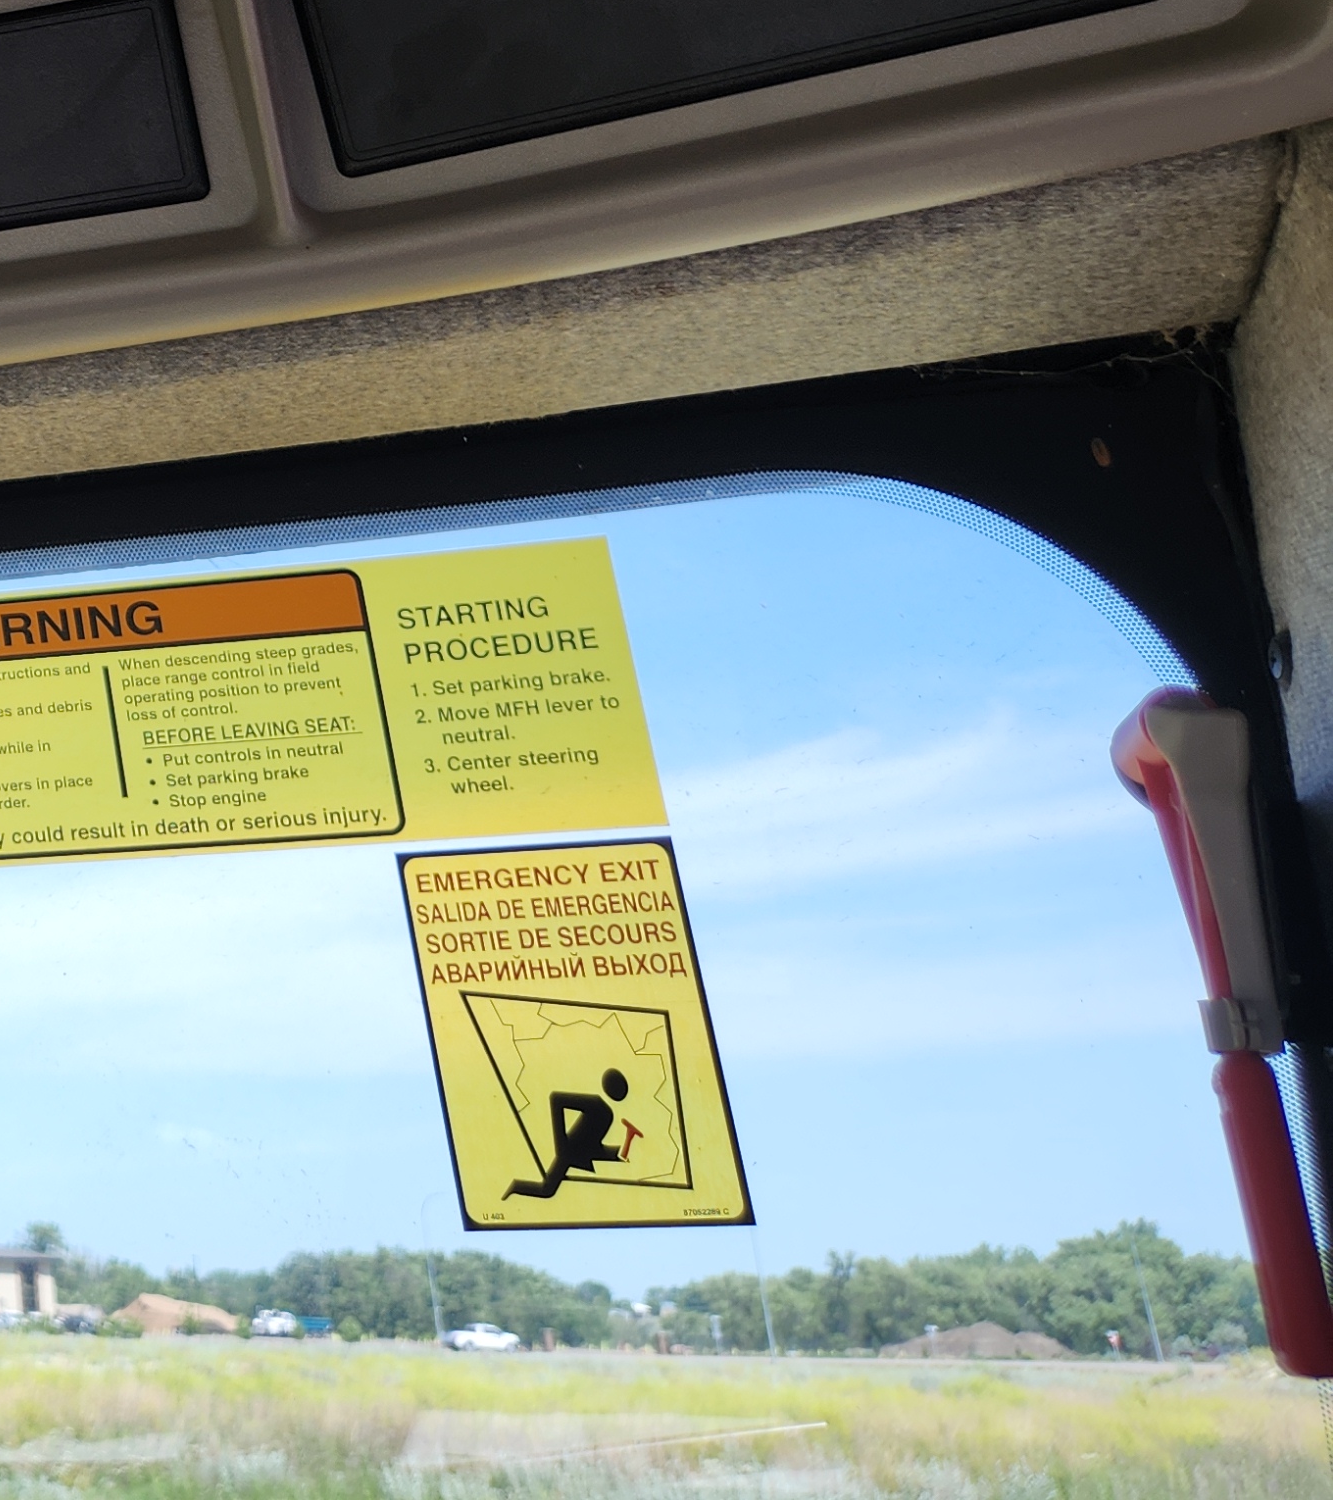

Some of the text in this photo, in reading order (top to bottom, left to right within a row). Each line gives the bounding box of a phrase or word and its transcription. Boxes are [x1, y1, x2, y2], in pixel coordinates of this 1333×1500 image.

[397, 596, 548, 629] STARTING
[118, 641, 357, 670] When descending steep grades,
[404, 627, 598, 663] PROCEDURE
[65, 662, 90, 674] and
[121, 660, 319, 690] place range control in field
[124, 677, 340, 706] operating position to prevent
[412, 669, 609, 696] 1. Set parking brake.
[17, 703, 42, 715] and
[47, 699, 91, 713] debris
[126, 701, 237, 720] loss of control.
[415, 696, 618, 723] 2. Move MFH lever to
[143, 716, 354, 745] BEFORE LEAVING SEAT:
[442, 725, 514, 743] neutral.
[38, 740, 50, 751] in
[163, 741, 342, 766] Put controls in neutral
[424, 748, 598, 772] 3. Center steering
[36, 777, 49, 789] in
[54, 776, 92, 791] place
[166, 765, 308, 788] Set parking brake
[451, 776, 512, 793] wheel.
[169, 789, 265, 809] Stop engine
[12, 825, 63, 843] could
[71, 822, 124, 840] result
[131, 820, 148, 836] in
[155, 816, 208, 834] death
[216, 818, 234, 831] or
[243, 811, 316, 829] serious
[323, 806, 385, 827] injury.
[416, 859, 658, 892] EMERGENCY EXIT
[416, 891, 674, 923] SALIDA DE EMERGENCIA
[426, 921, 676, 953] SORTIE DE SECOURS
[432, 952, 686, 984] АВАРИЙНЫЙ ВЫХОД
